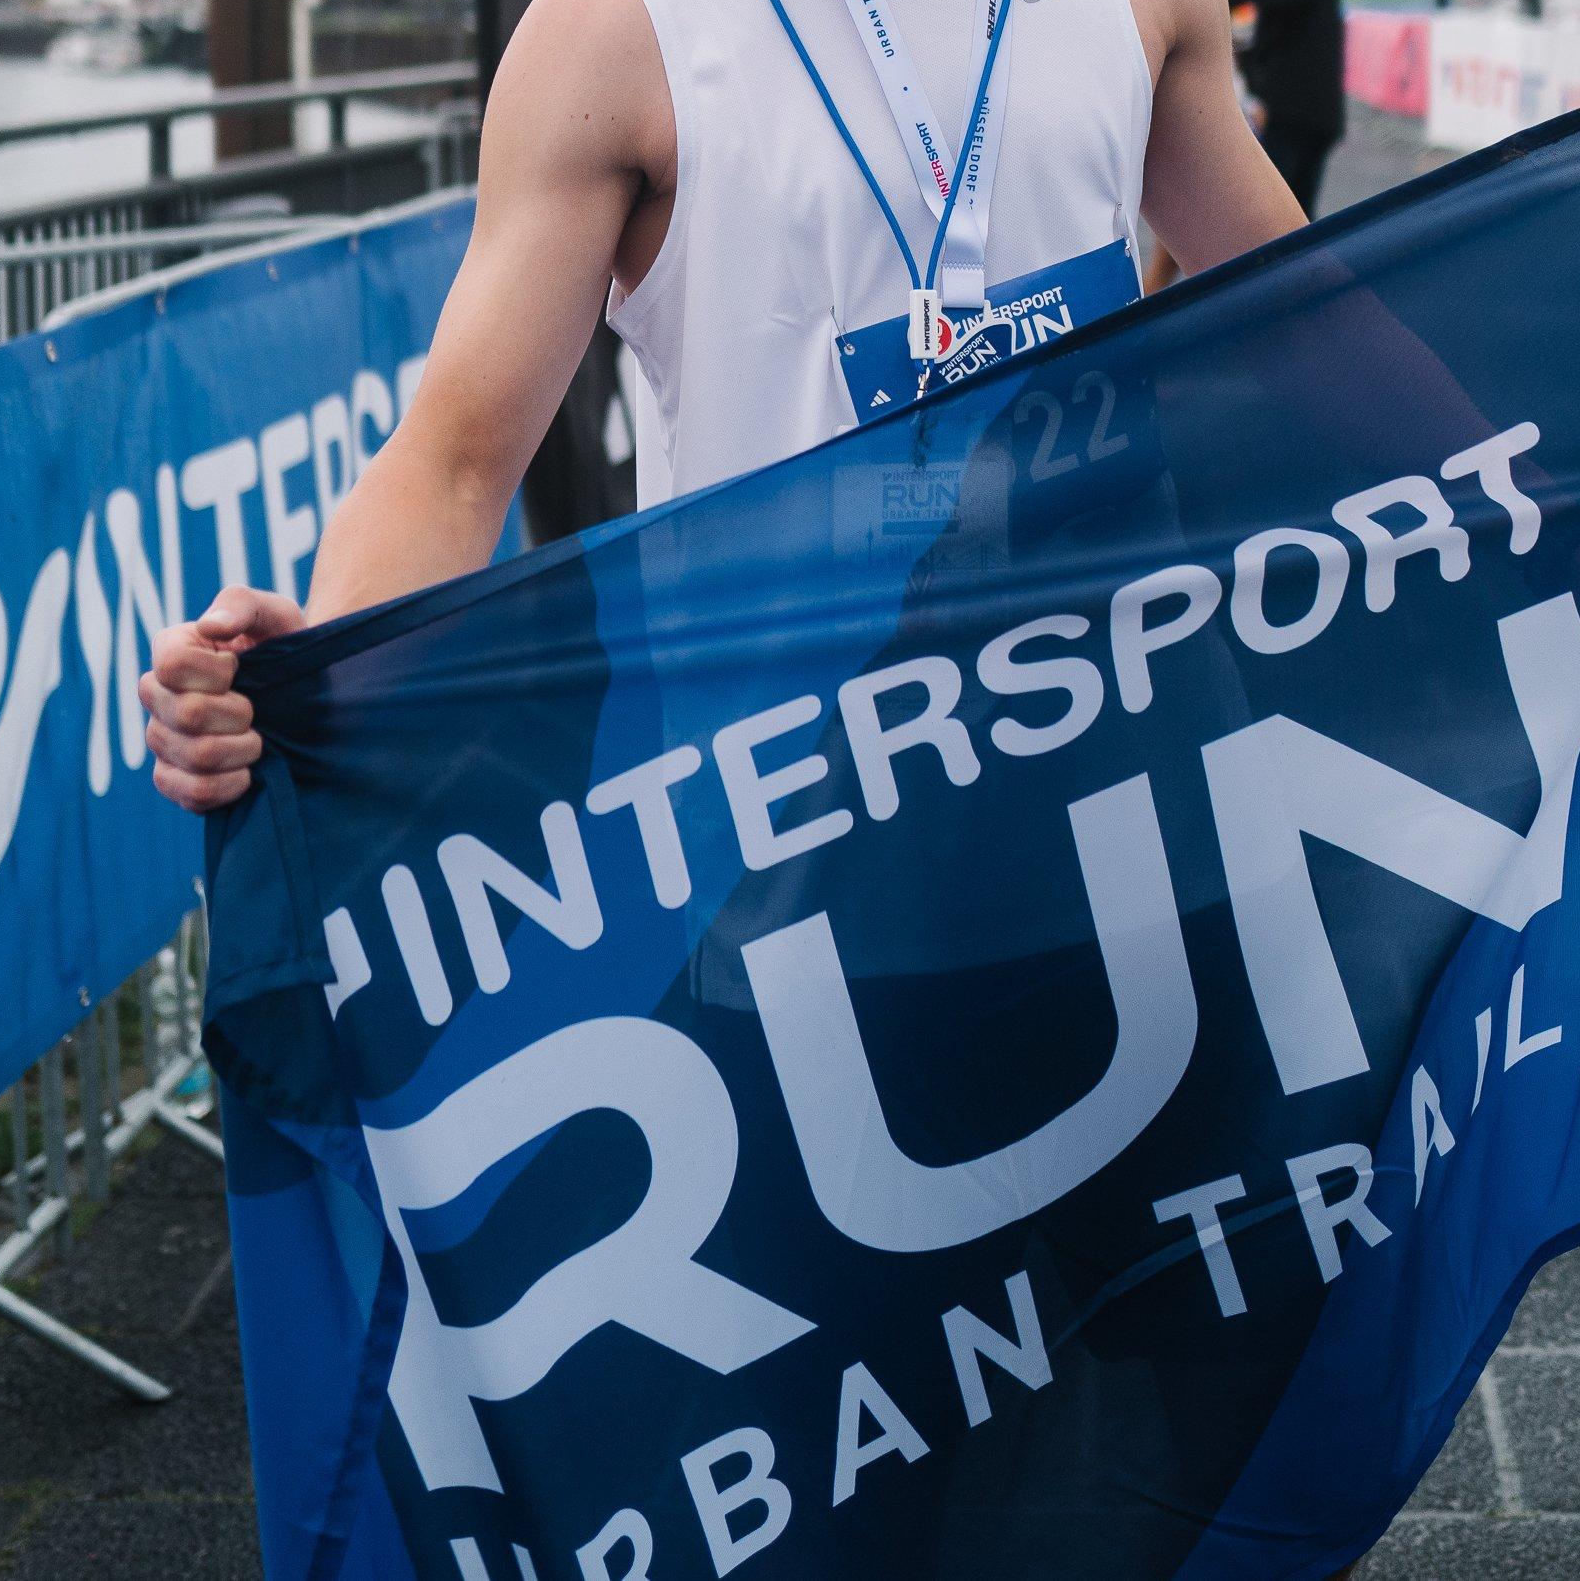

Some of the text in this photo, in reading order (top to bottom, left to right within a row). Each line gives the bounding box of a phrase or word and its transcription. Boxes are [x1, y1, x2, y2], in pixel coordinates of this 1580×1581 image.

[867, 10, 895, 58] URBAN
[915, 121, 953, 199] INTERSPORT
[963, 285, 1063, 334] INERSPORT
[944, 333, 986, 372] INTERSPORT
[381, 420, 1542, 1026] INTERSPORT
[1152, 963, 1563, 1319] TRAIL
